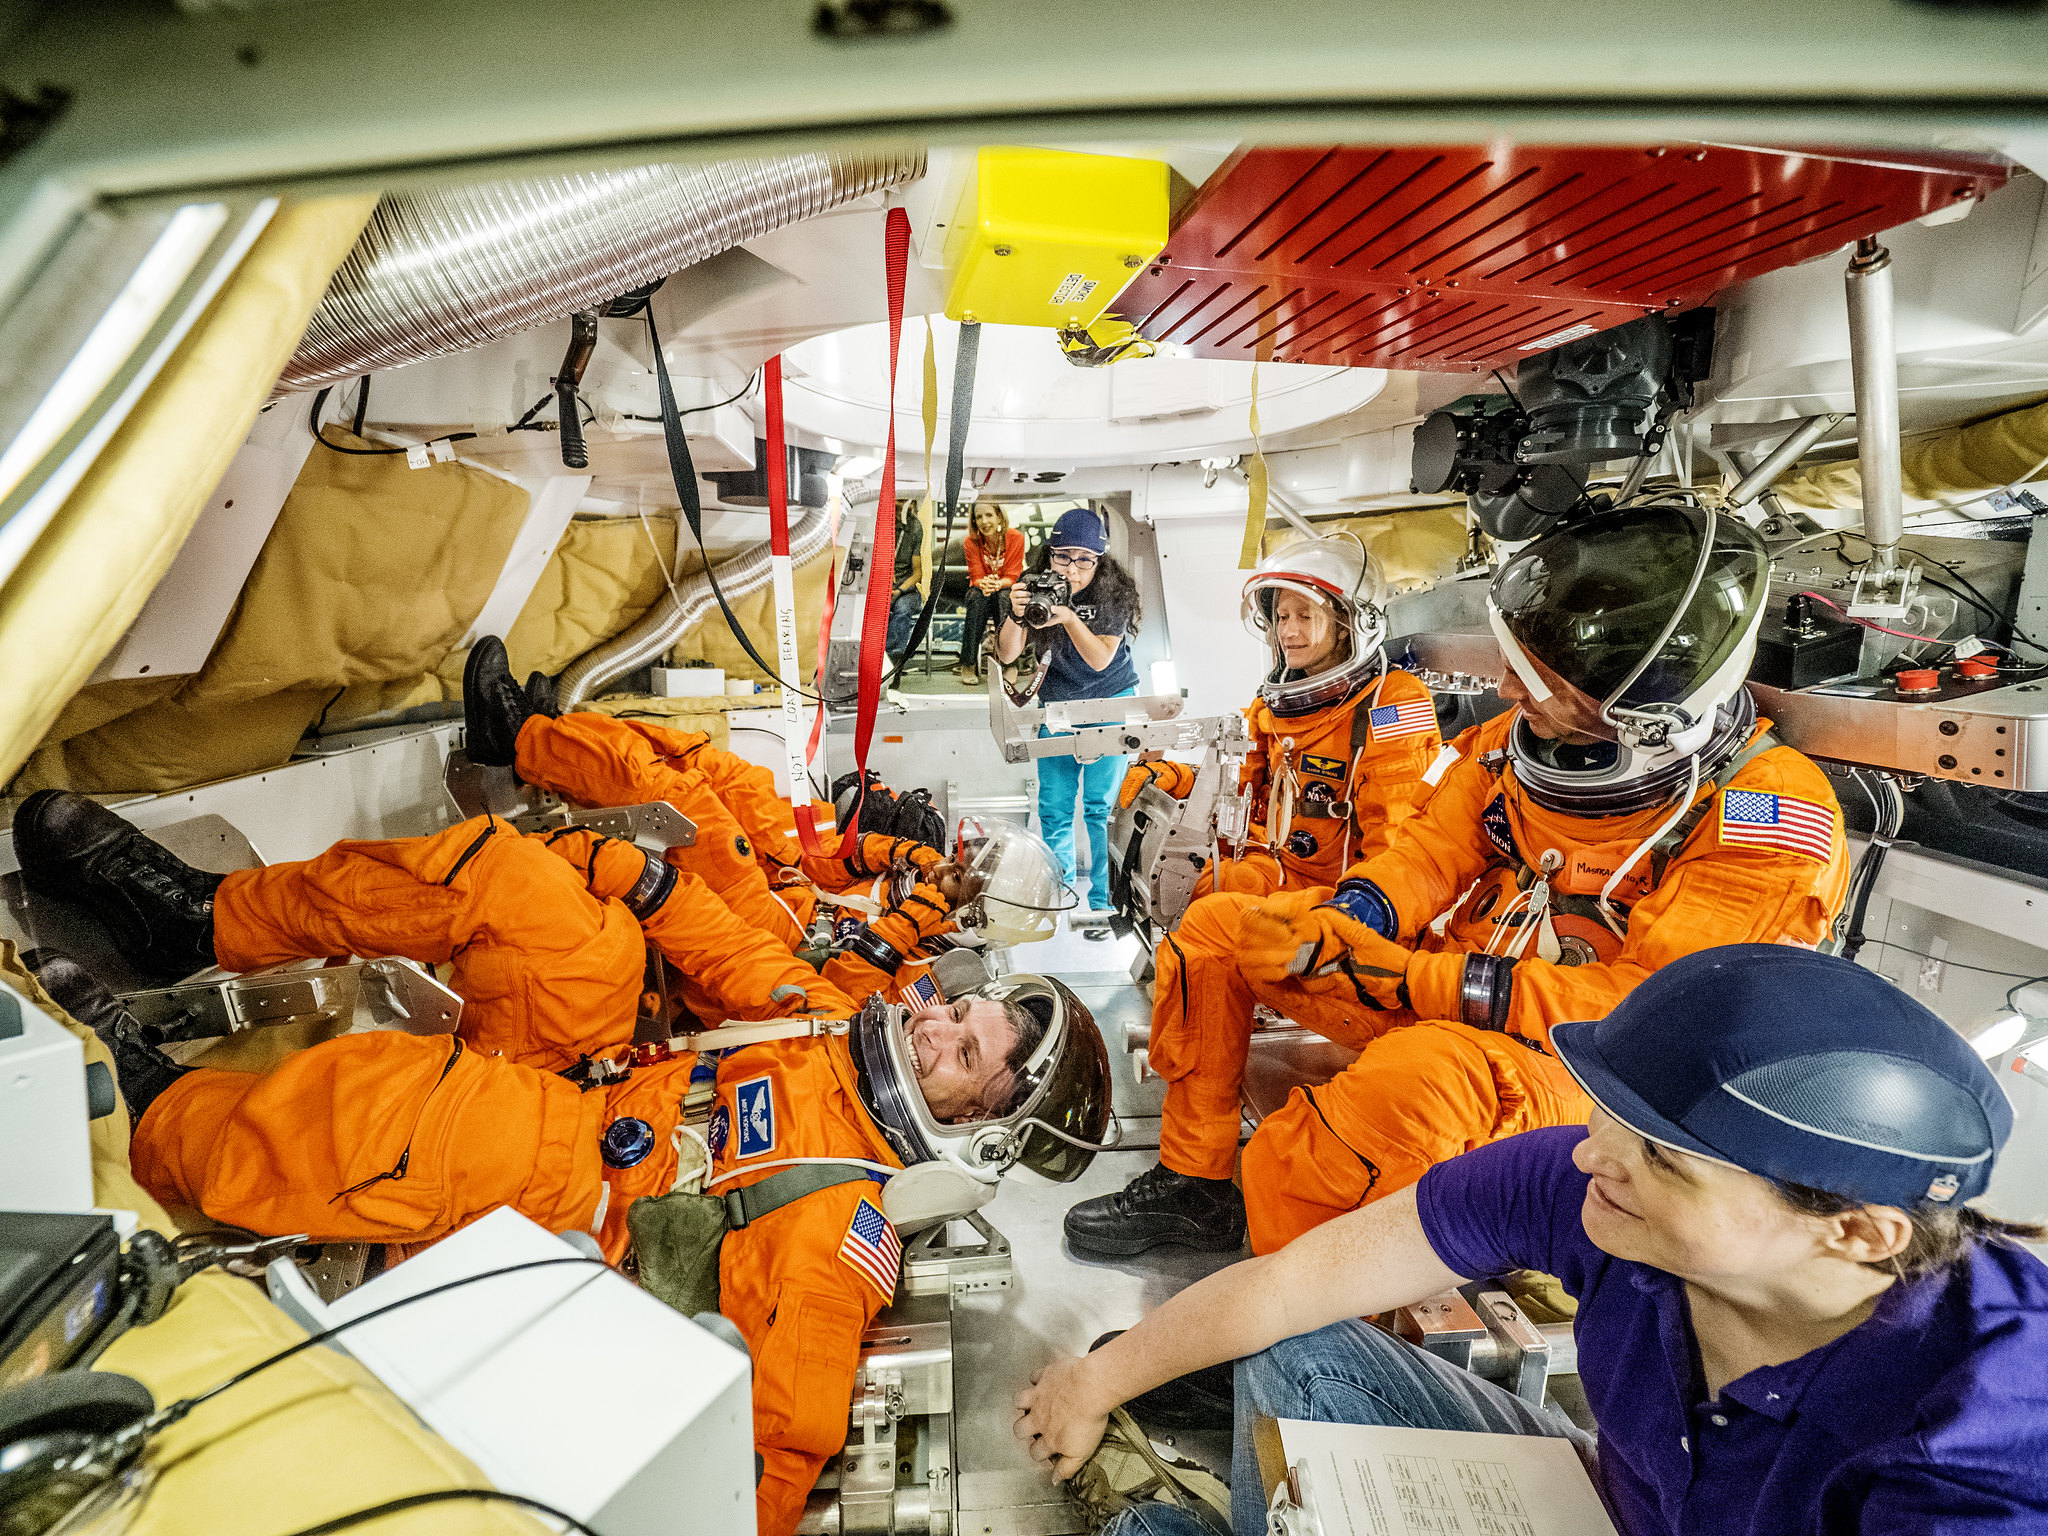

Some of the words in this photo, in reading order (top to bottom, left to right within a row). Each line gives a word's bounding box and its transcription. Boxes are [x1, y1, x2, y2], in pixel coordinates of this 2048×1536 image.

[1050, 274, 1082, 304] DETECTOR
[1072, 281, 1096, 301] SMOKE
[780, 608, 793, 660] BEARING
[1025, 671, 1044, 696] Canon
[786, 688, 798, 723] LOAD
[791, 752, 804, 782] NOT
[1307, 790, 1332, 803] NASA
[741, 1098, 749, 1114] MIKE
